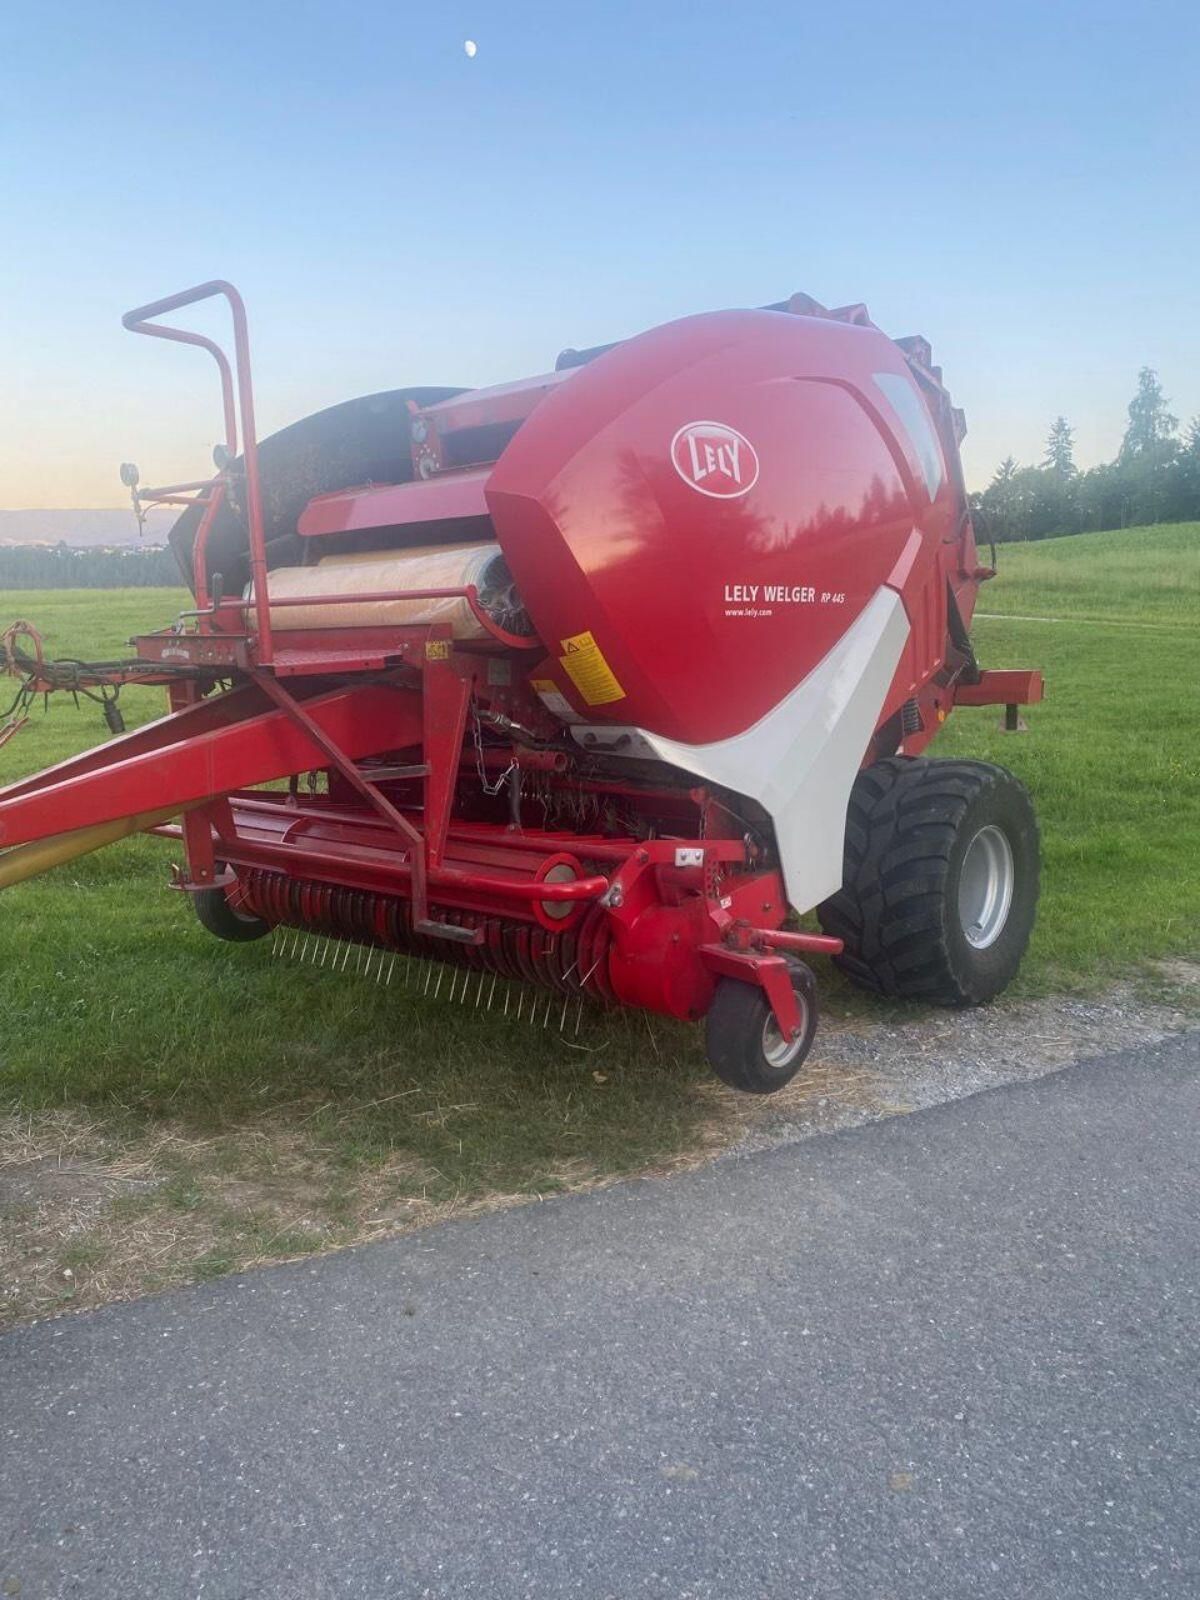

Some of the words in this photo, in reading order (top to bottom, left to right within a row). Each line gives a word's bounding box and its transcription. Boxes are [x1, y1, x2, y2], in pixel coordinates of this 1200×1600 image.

[688, 434, 741, 484] LELY
[724, 585, 759, 602] LELY
[764, 586, 815, 602] WELGER
[820, 592, 831, 603] RP
[832, 593, 845, 604] 445
[724, 608, 772, 618] www.lely.com
